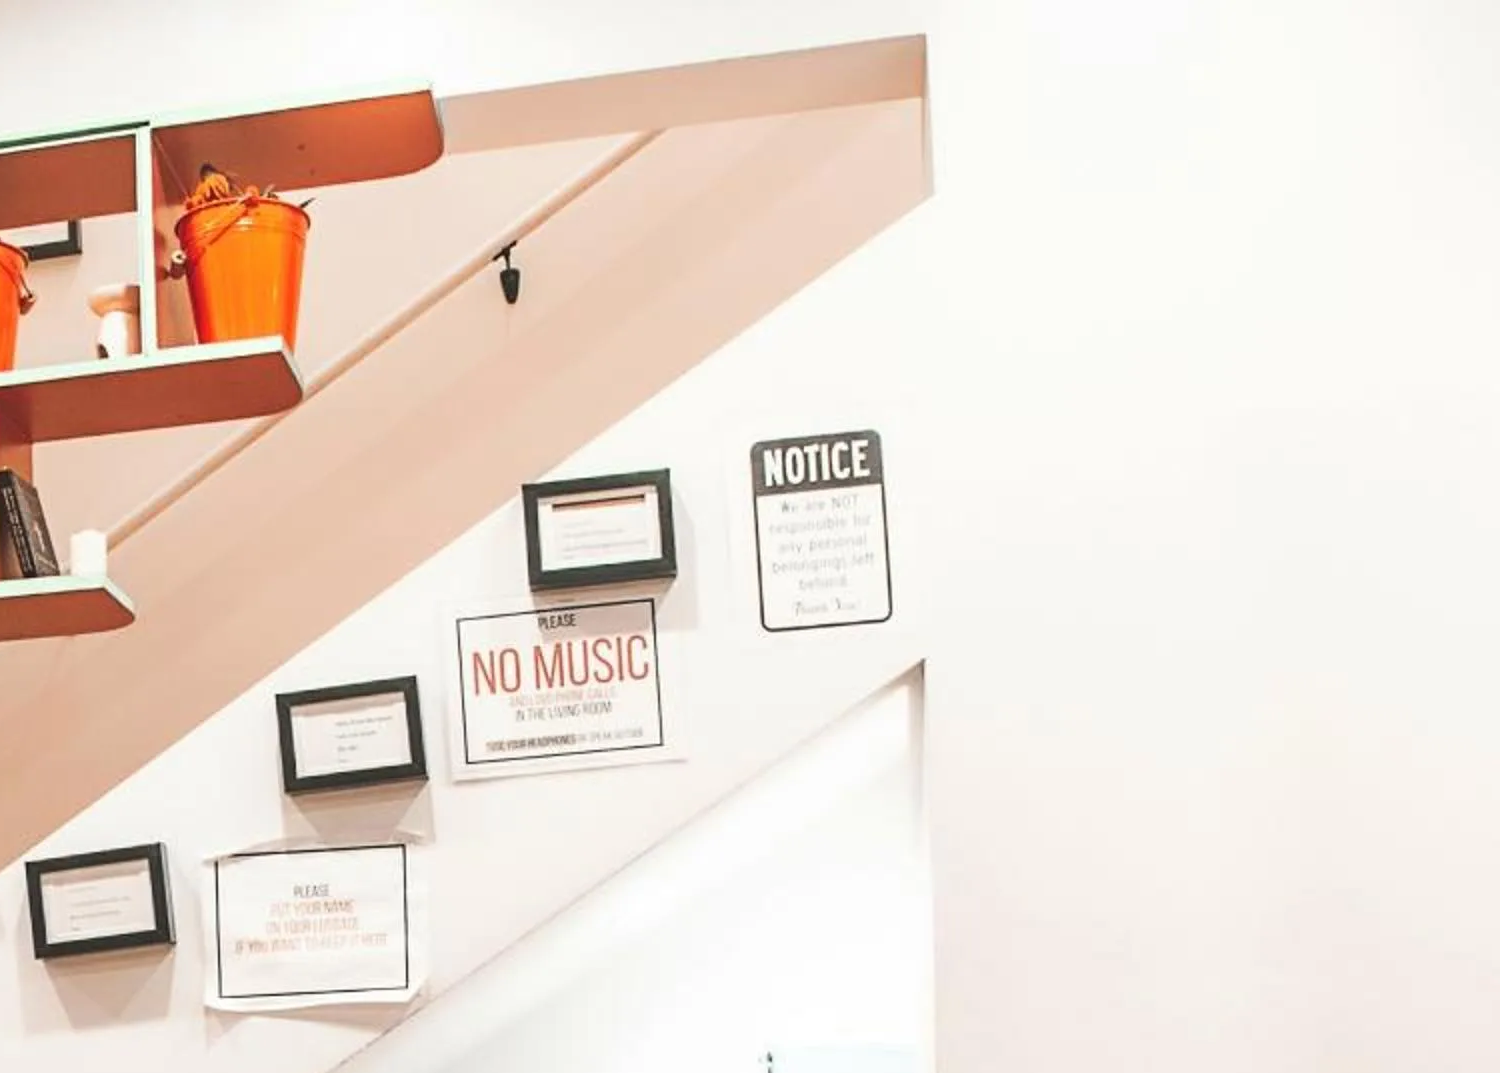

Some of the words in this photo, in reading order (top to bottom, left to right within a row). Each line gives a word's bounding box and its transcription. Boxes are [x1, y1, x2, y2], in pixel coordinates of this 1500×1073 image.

[763, 439, 870, 487] NOTICE
[537, 613, 577, 630] PLEASE
[472, 648, 521, 696] NO
[533, 635, 650, 690] MUSIC
[527, 707, 546, 721] THE
[548, 704, 581, 720] LIVING
[582, 700, 613, 715] ROOM
[293, 883, 330, 898] PLEASE
